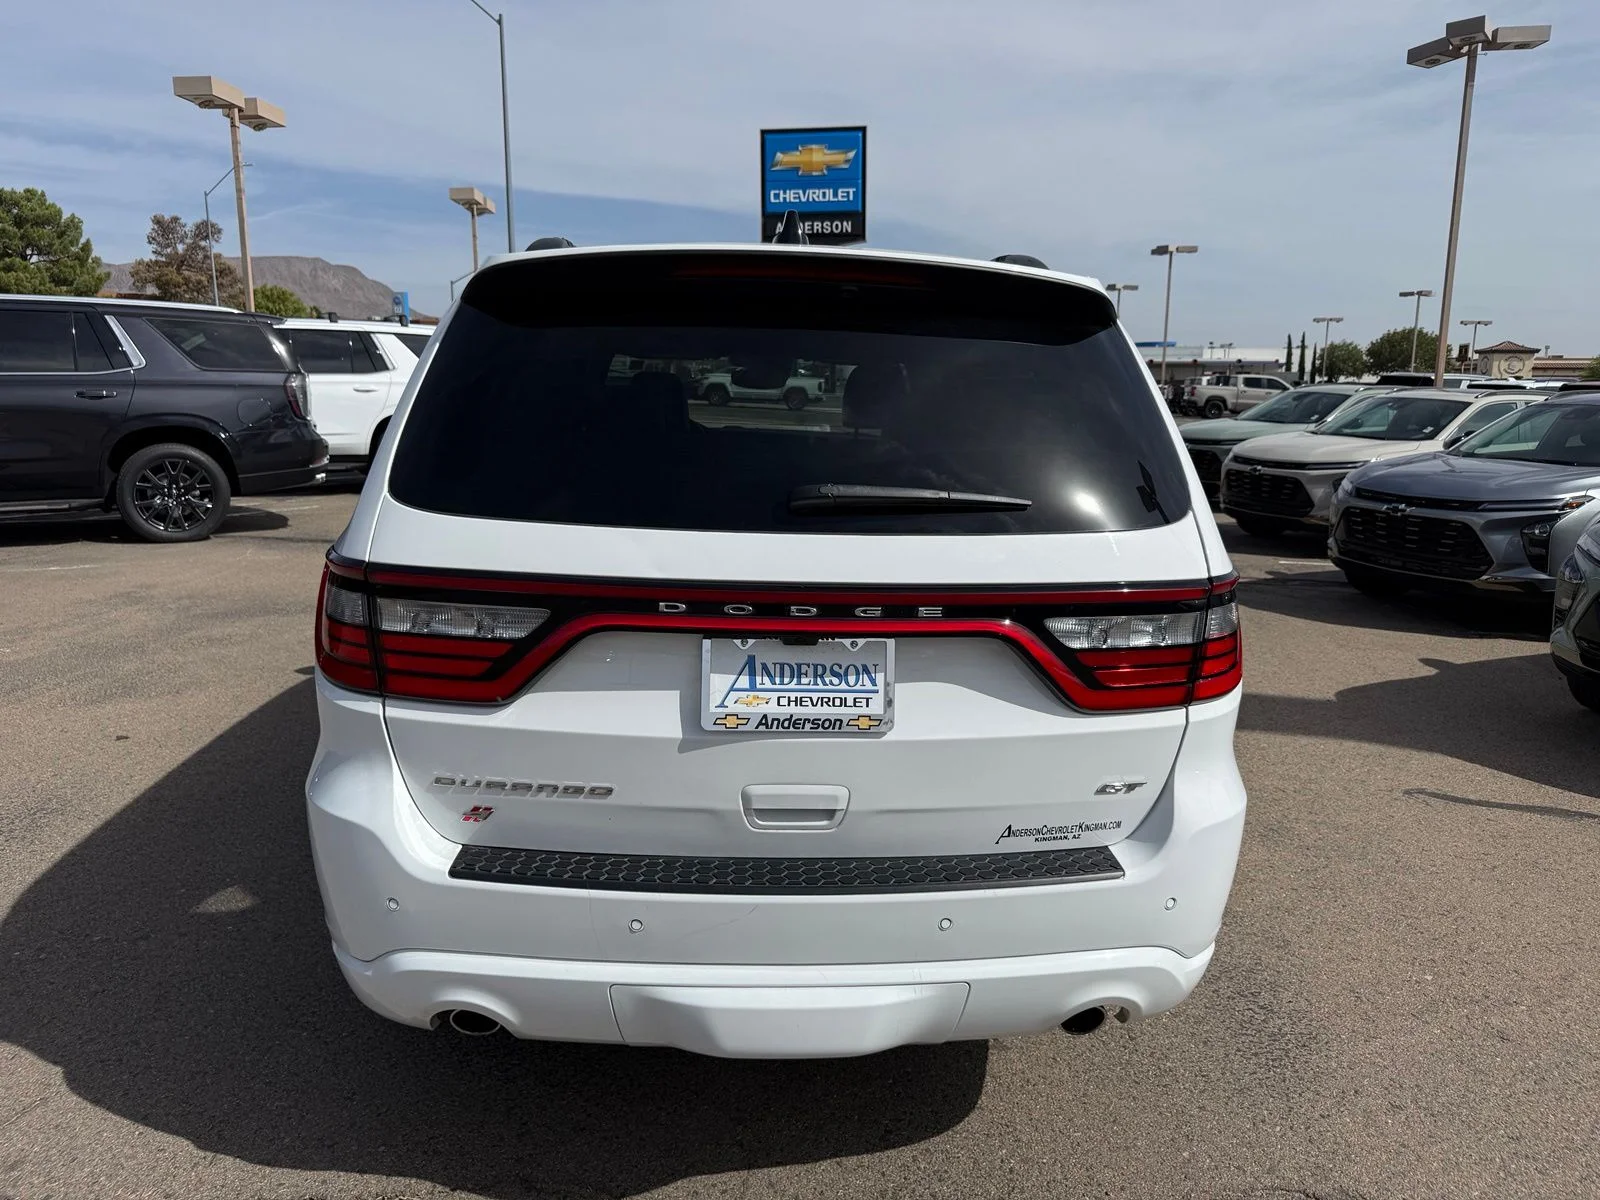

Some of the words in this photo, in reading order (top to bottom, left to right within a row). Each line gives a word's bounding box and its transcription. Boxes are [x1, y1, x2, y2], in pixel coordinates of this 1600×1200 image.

[770, 188, 856, 203] CHEVROLET
[775, 220, 852, 234] AERSON
[658, 601, 943, 617] DODGE
[715, 654, 879, 708] ANDERSON
[776, 695, 873, 708] CHEVROLET
[755, 713, 843, 731] Anderson
[432, 775, 614, 797] DURANGO
[1093, 781, 1147, 796] GT
[1034, 834, 1070, 843] KINGMAN,
